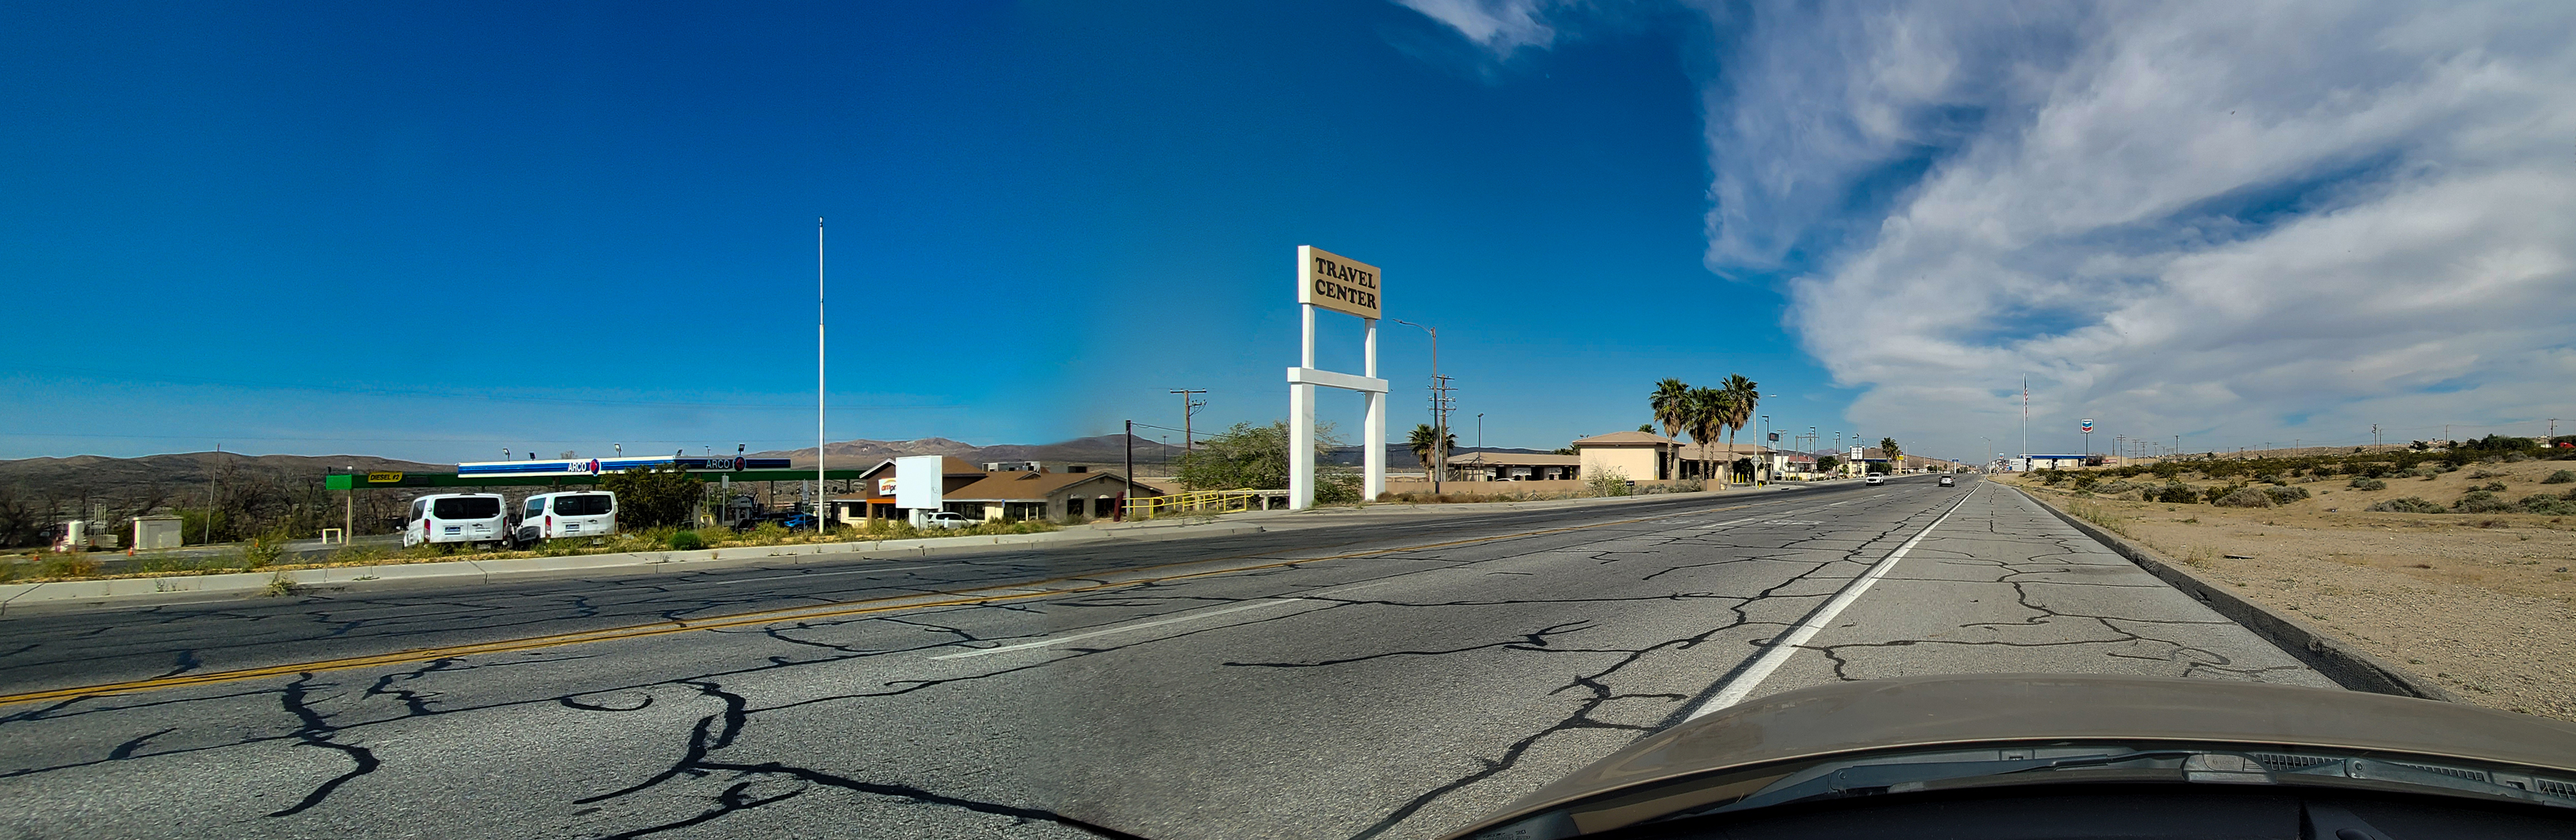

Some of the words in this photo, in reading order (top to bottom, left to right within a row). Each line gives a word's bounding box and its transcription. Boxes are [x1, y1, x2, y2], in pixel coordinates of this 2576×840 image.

[1316, 257, 1376, 289] TRAVEL
[1315, 279, 1377, 310] CENTER
[568, 463, 587, 472] ARCO
[706, 459, 730, 468] ARCO
